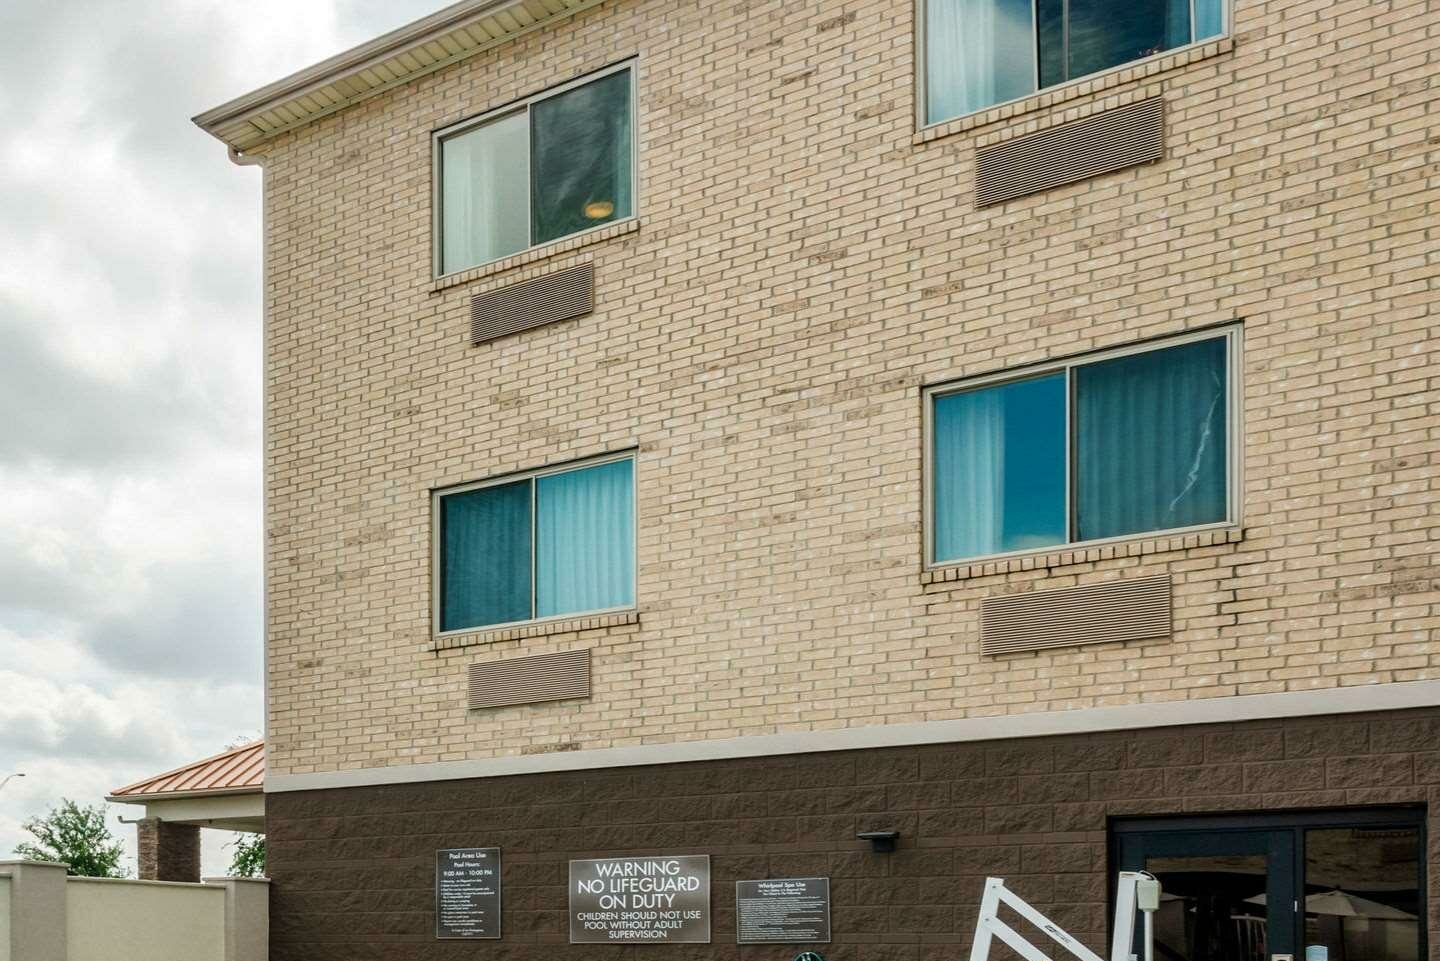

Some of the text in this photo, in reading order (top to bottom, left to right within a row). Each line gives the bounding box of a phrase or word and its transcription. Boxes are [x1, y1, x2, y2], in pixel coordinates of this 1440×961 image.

[596, 860, 680, 877] WARNING
[578, 876, 700, 894] NO LIFEGUARD
[599, 893, 675, 909] ON DUTY
[577, 910, 701, 921] CHILDREN SHOULD NOT USE
[584, 920, 683, 930] POOL WITHOUT ADULT
[609, 930, 667, 939] SUPERVISION
